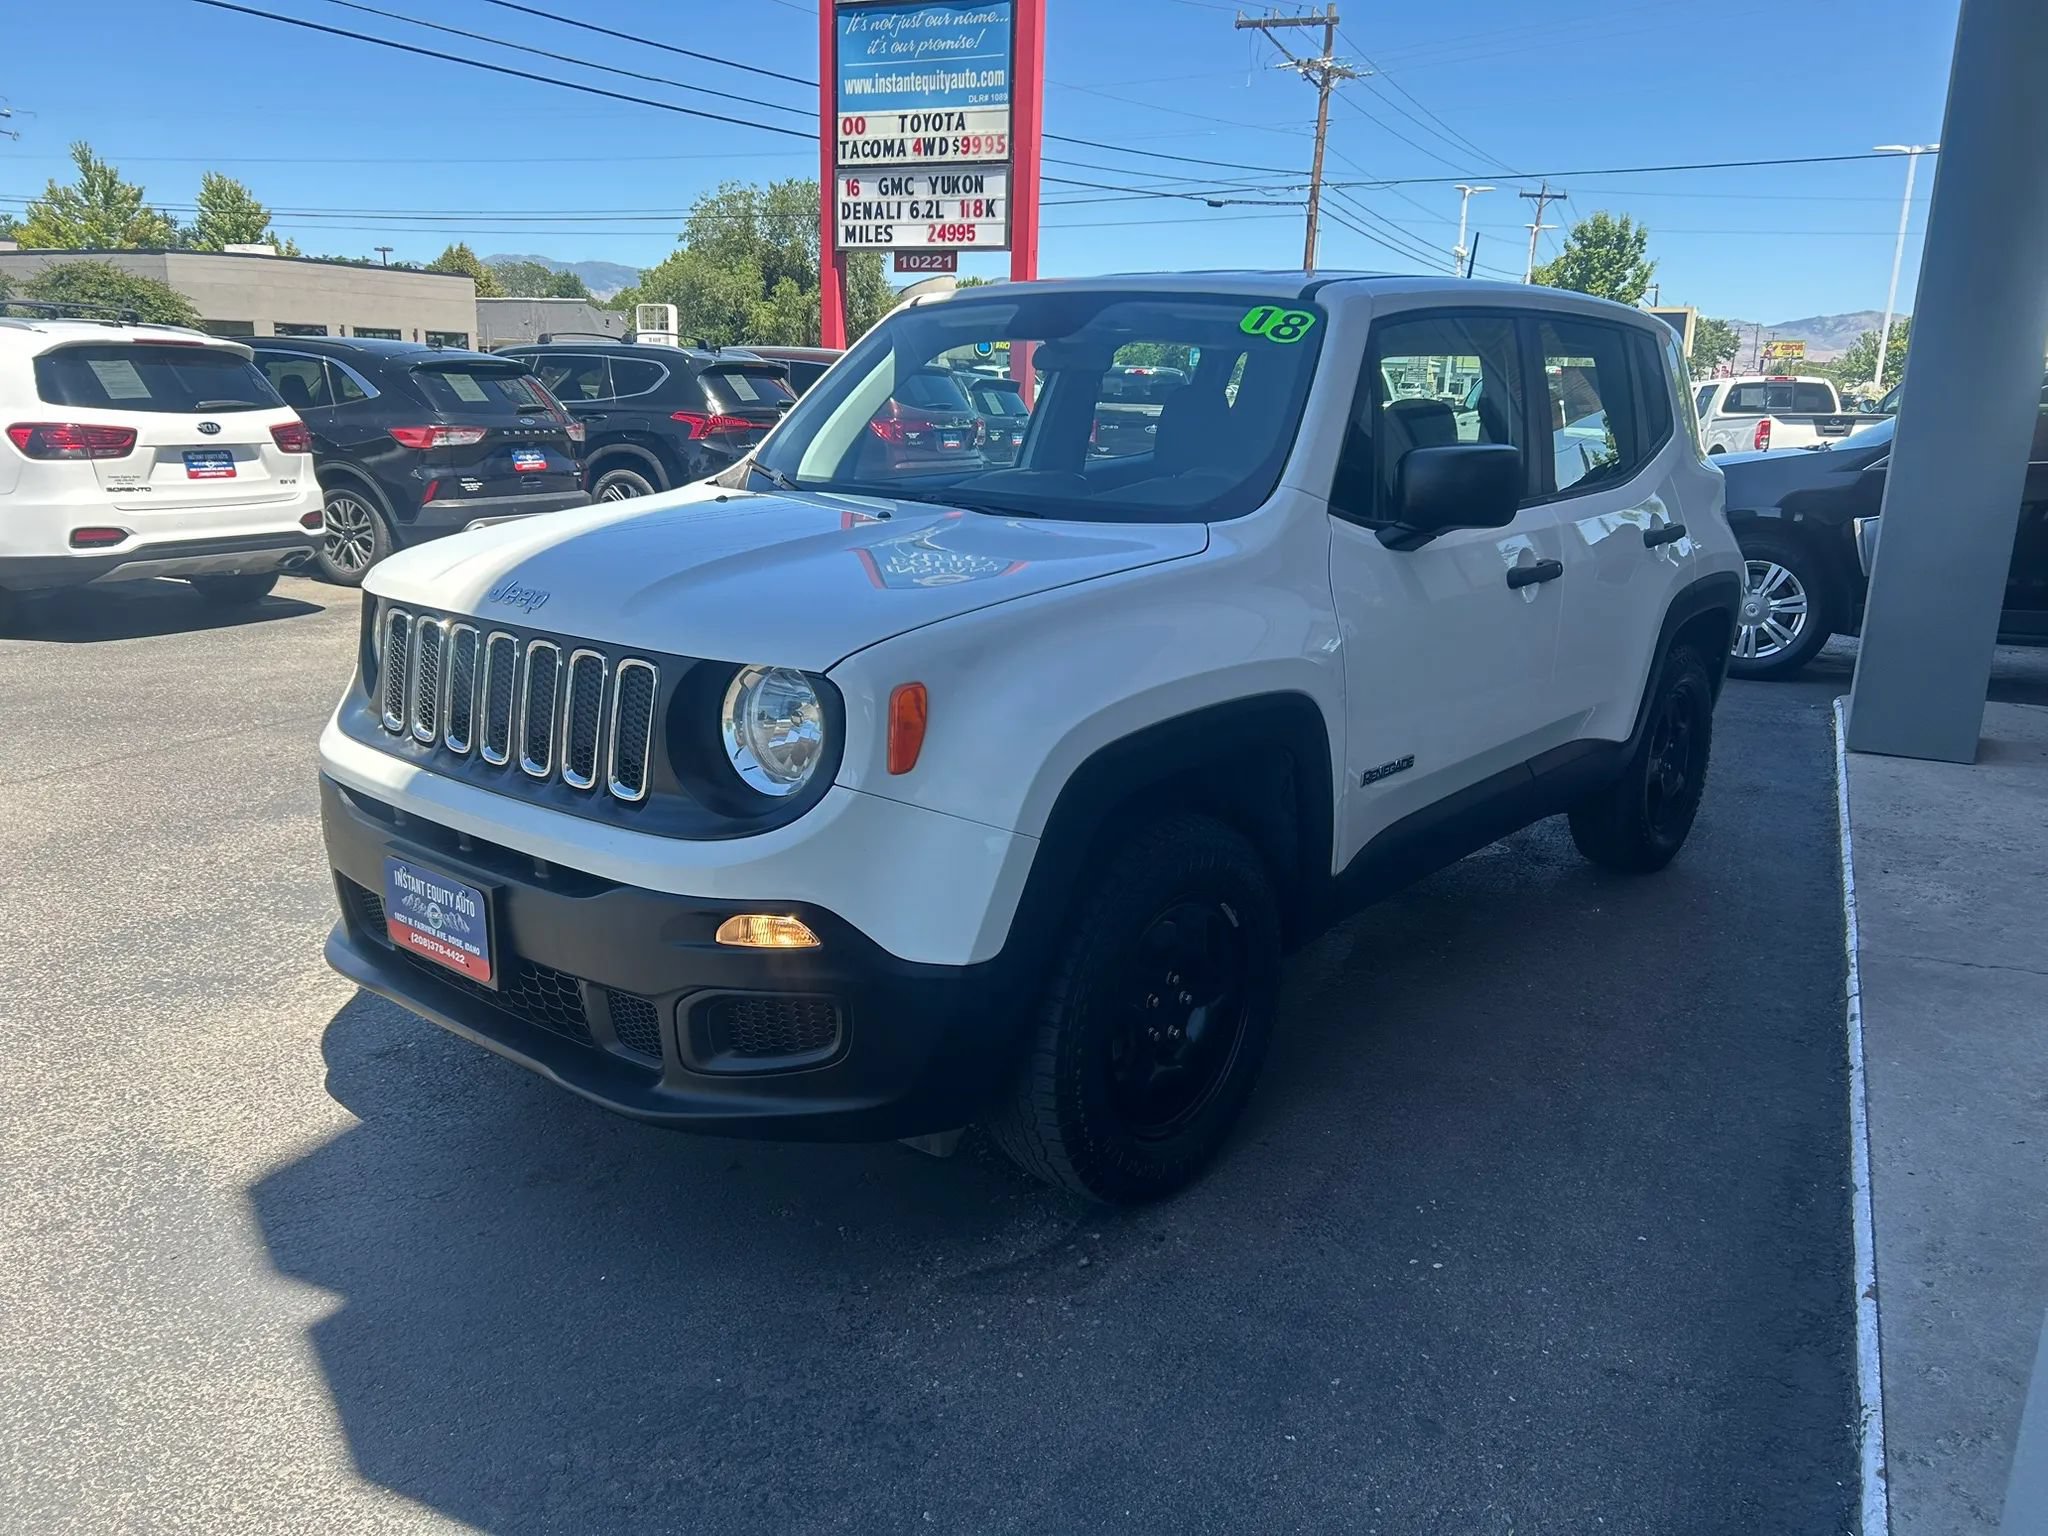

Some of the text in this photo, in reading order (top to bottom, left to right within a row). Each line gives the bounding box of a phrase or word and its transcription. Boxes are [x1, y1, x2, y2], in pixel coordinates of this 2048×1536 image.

[846, 13, 866, 34] It's
[871, 14, 899, 31] not
[890, 12, 924, 37] just
[925, 13, 950, 27] our
[867, 28, 986, 58] it's our promise!
[844, 69, 1004, 95] www.instantequityauto.com
[969, 94, 988, 103] DLR#
[842, 112, 966, 135] 00 TOYOTA
[840, 134, 1006, 160] TACOMA 4WD $9995
[846, 175, 984, 196] 16 GMC YUKON
[842, 199, 996, 220] DENALI 6.2L 118K
[845, 224, 975, 243] MILES 24995
[900, 255, 953, 269] 10221
[1247, 307, 1312, 341] 18
[201, 423, 219, 433] KIA
[488, 580, 550, 614] Jeep
[1360, 754, 1415, 788] RENEGADE
[394, 870, 475, 917] INSTANT EQUITY AUTO
[411, 932, 465, 964] (208)378-4422
[464, 942, 480, 955] IDAHO
